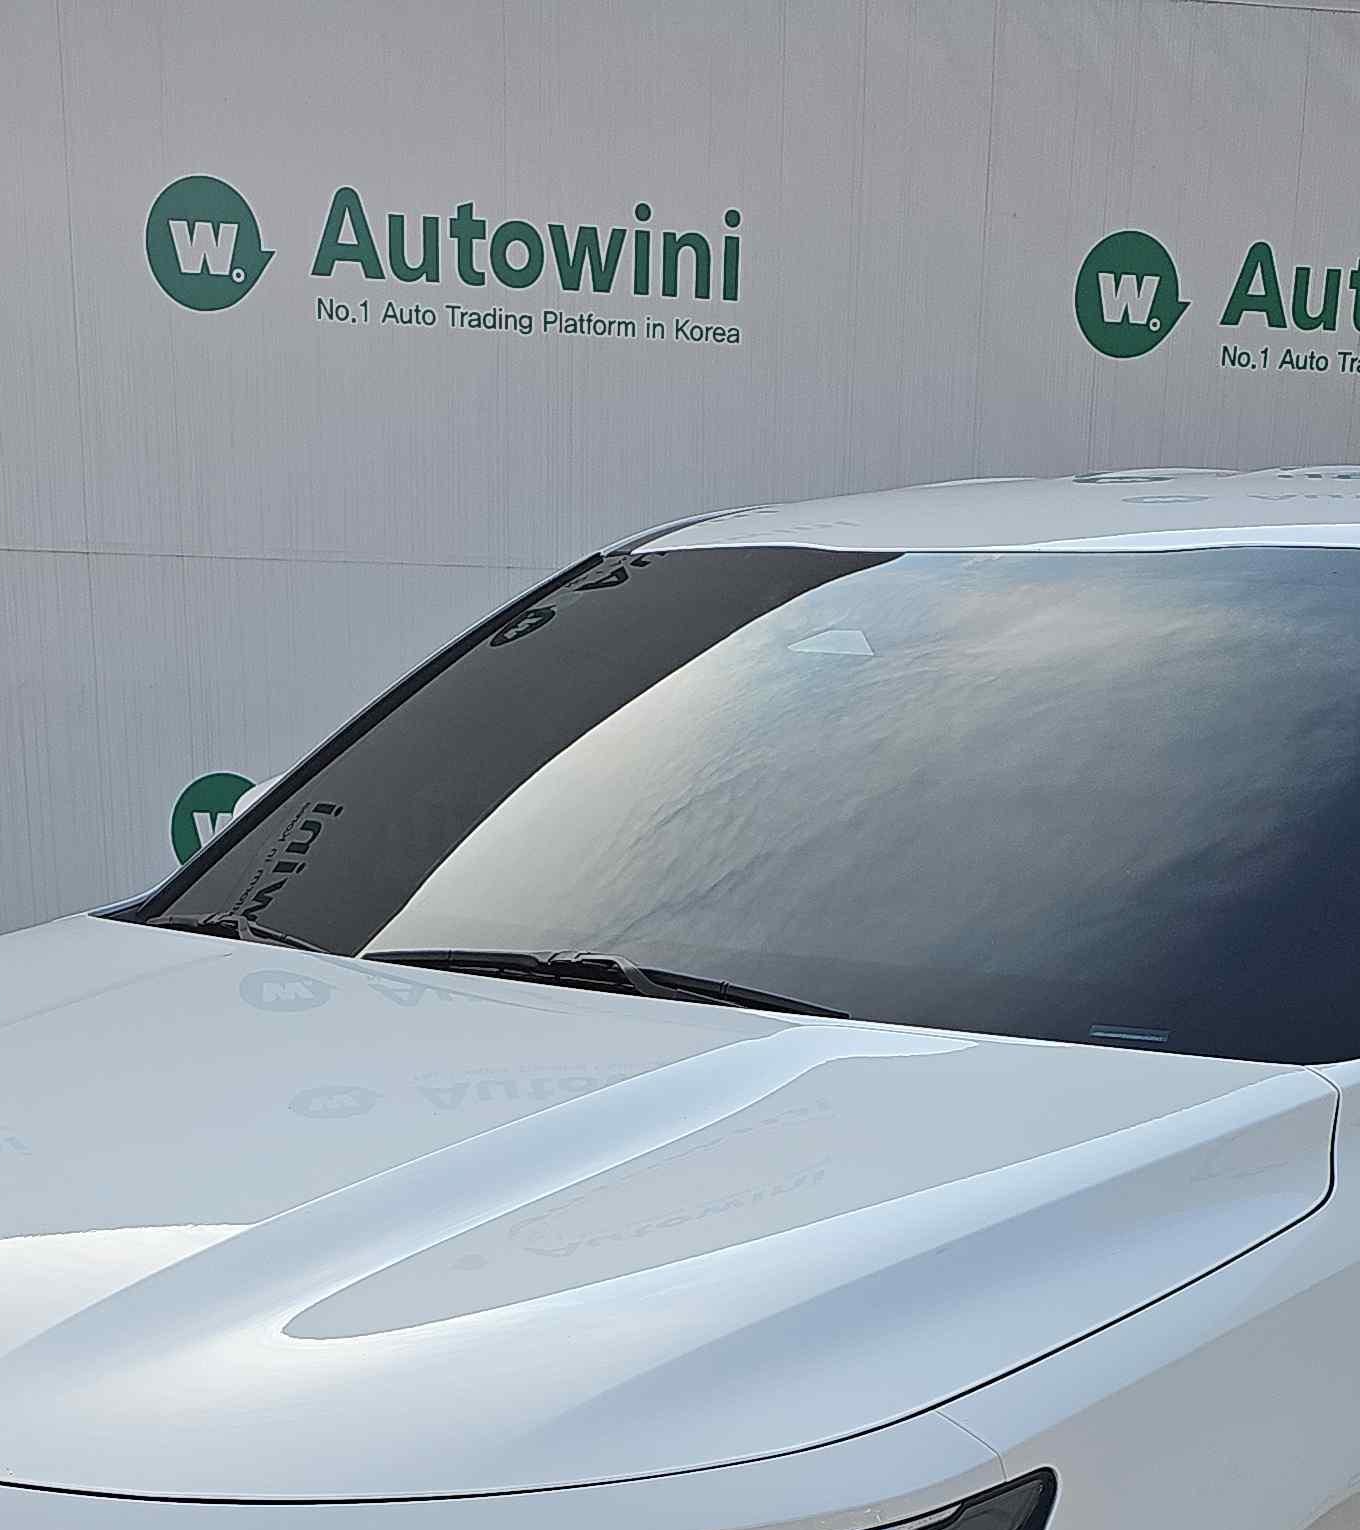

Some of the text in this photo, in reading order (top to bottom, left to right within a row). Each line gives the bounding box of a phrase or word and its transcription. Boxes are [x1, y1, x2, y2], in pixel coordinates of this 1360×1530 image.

[310, 186, 741, 302] Autowini
[317, 297, 740, 344] No.1 Auto Trading Platform in Korea
[1221, 345, 1269, 369] No.1
[1278, 348, 1329, 372] Auto
